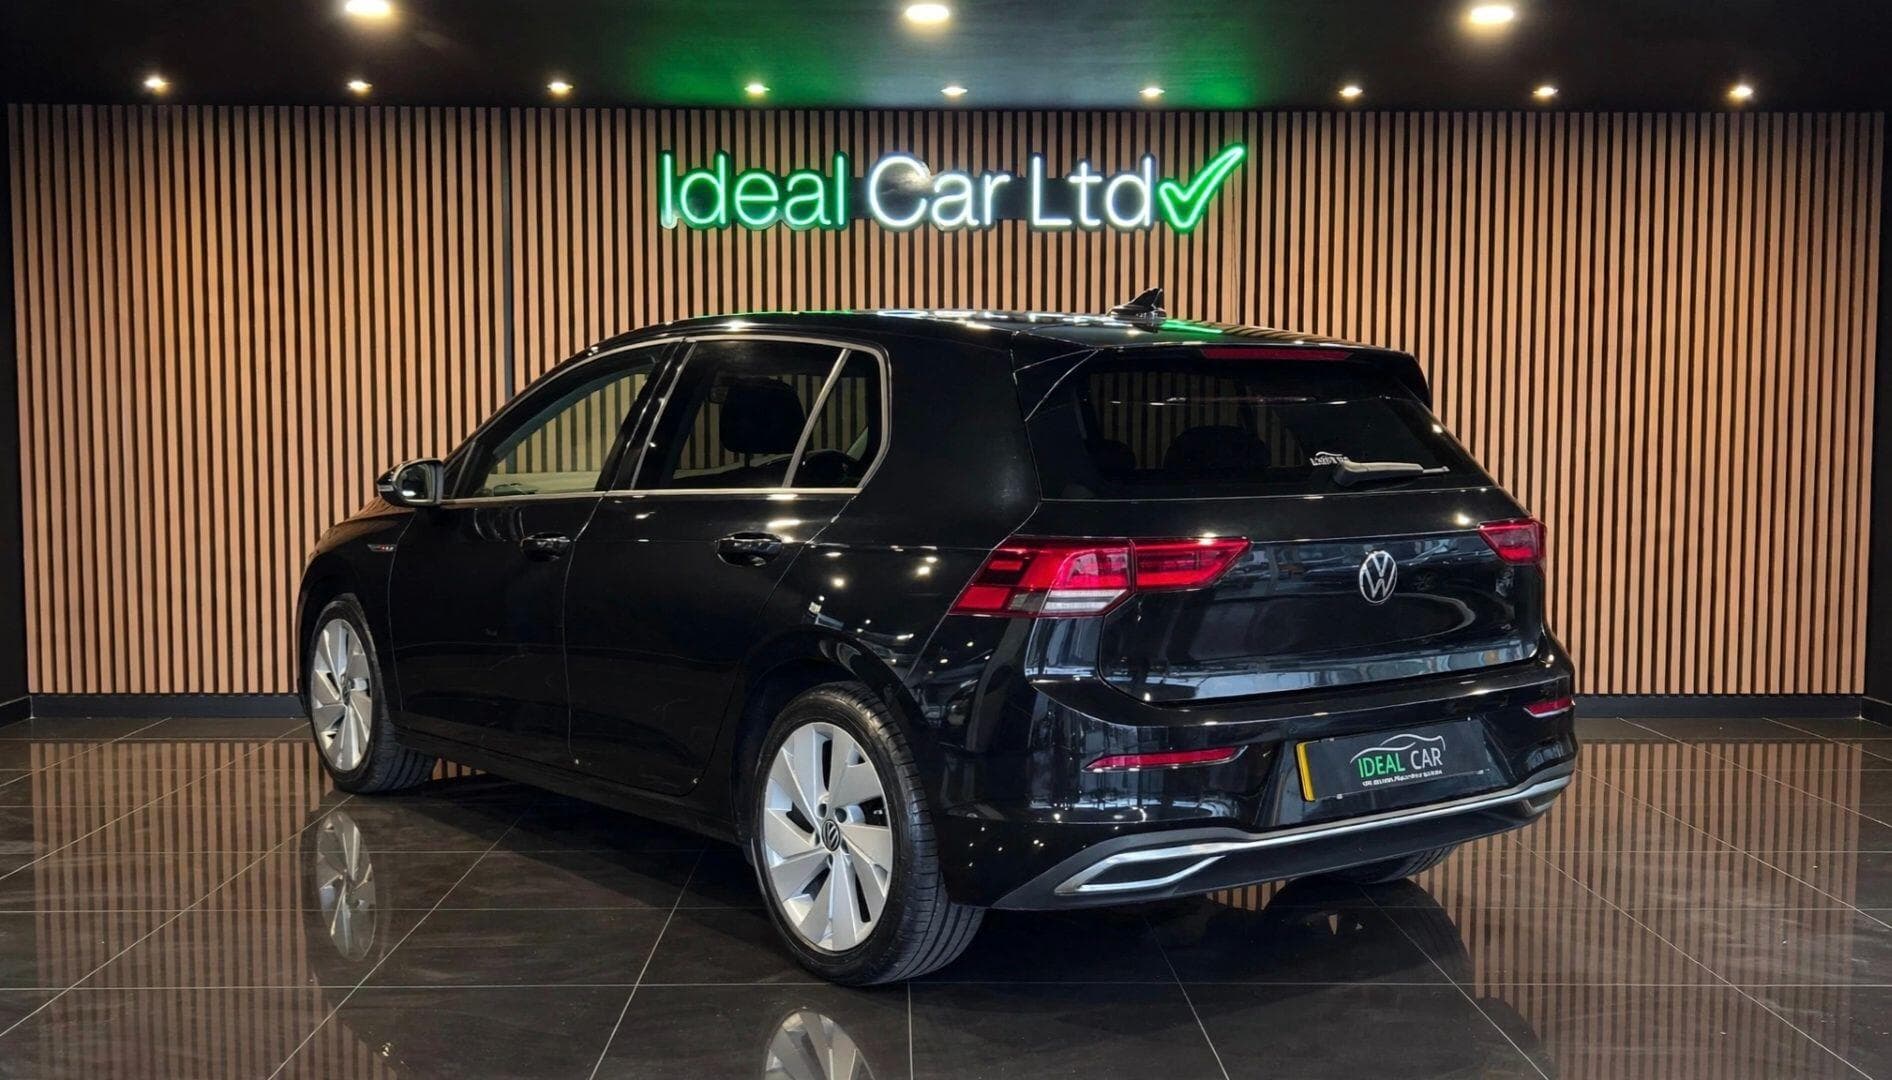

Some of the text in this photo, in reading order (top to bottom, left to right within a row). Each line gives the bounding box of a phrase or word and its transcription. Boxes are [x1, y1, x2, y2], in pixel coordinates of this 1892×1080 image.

[662, 152, 1153, 228] Ideal Car Ltd
[1360, 551, 1397, 602] VW
[1358, 752, 1406, 778] IDEAL
[1410, 747, 1444, 770] CAR
